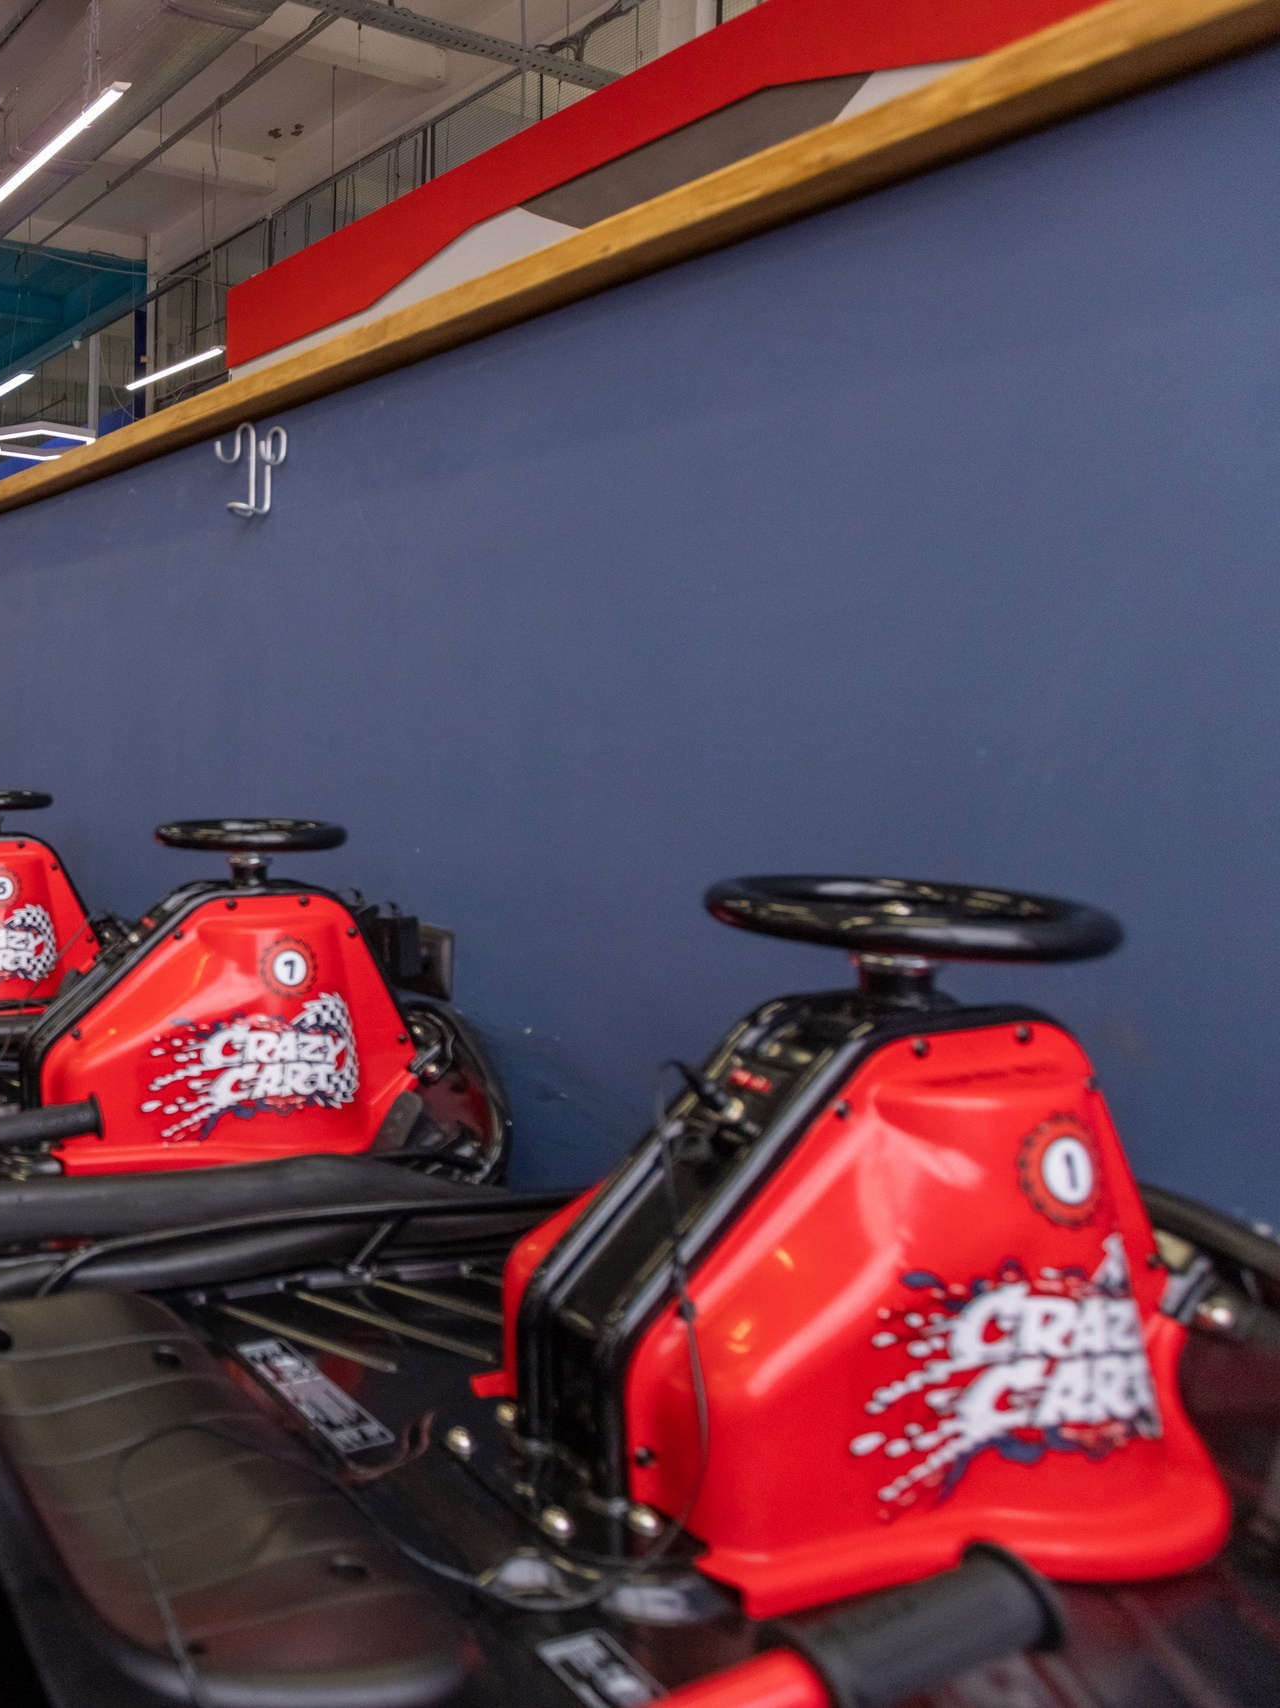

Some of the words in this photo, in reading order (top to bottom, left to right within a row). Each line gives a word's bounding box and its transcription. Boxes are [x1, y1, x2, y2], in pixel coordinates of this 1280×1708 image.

[284, 960, 295, 980] 7
[200, 1023, 347, 1068] CRAZY
[211, 1062, 332, 1108] CART
[1064, 1151, 1079, 1190] 1
[946, 1282, 1144, 1370] CRAZ
